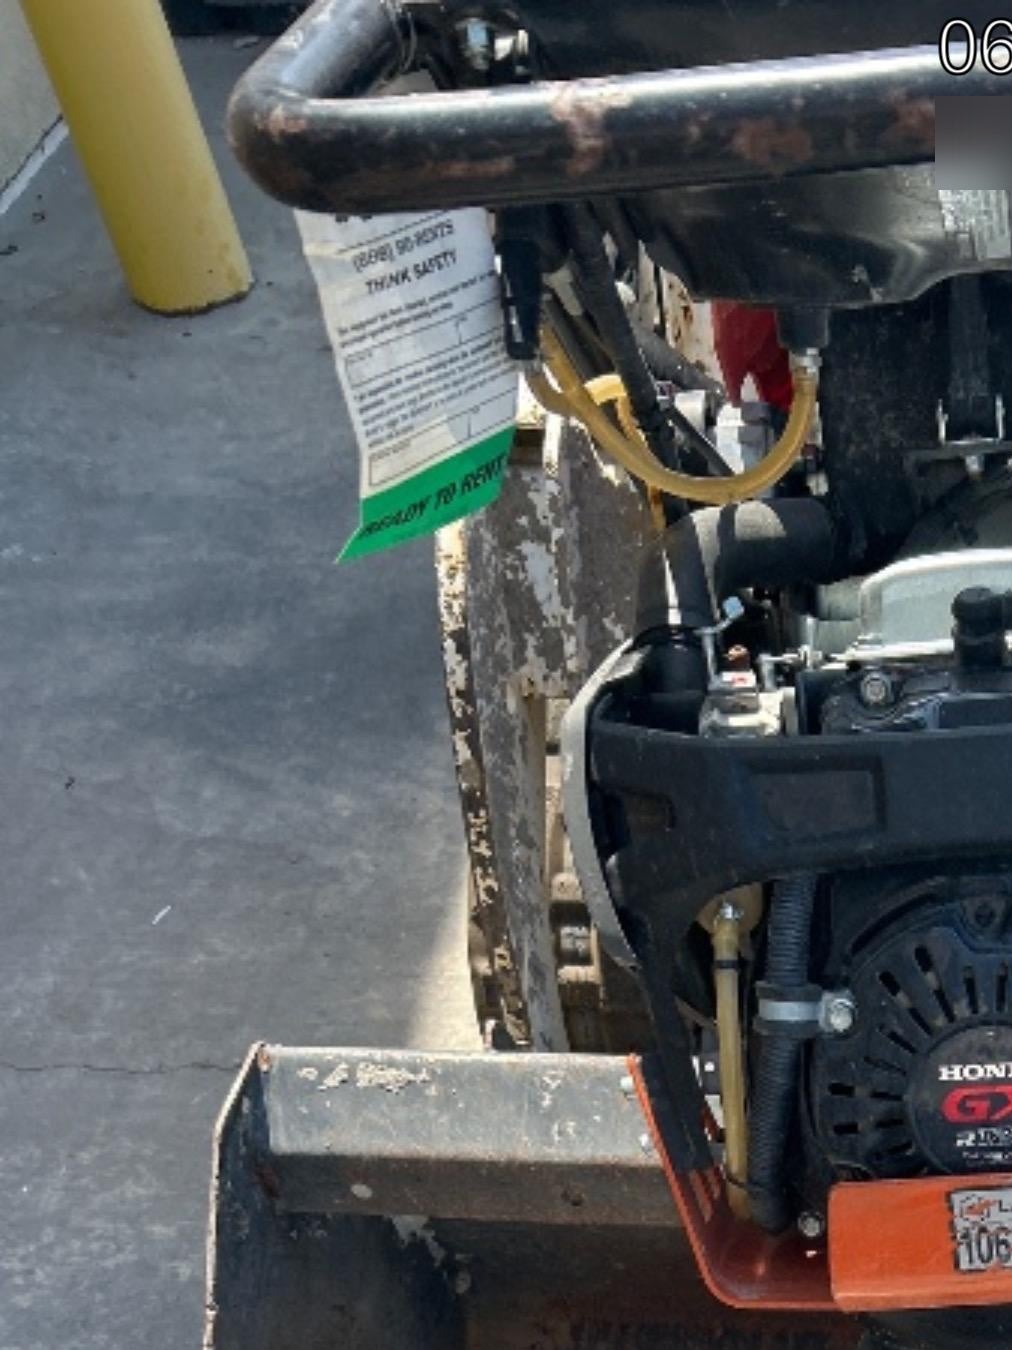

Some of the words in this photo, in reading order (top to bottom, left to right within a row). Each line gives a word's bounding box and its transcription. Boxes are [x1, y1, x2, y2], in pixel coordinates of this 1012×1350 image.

[365, 267, 412, 295] THINK
[414, 249, 457, 280] SAFETY
[434, 482, 457, 510] TO
